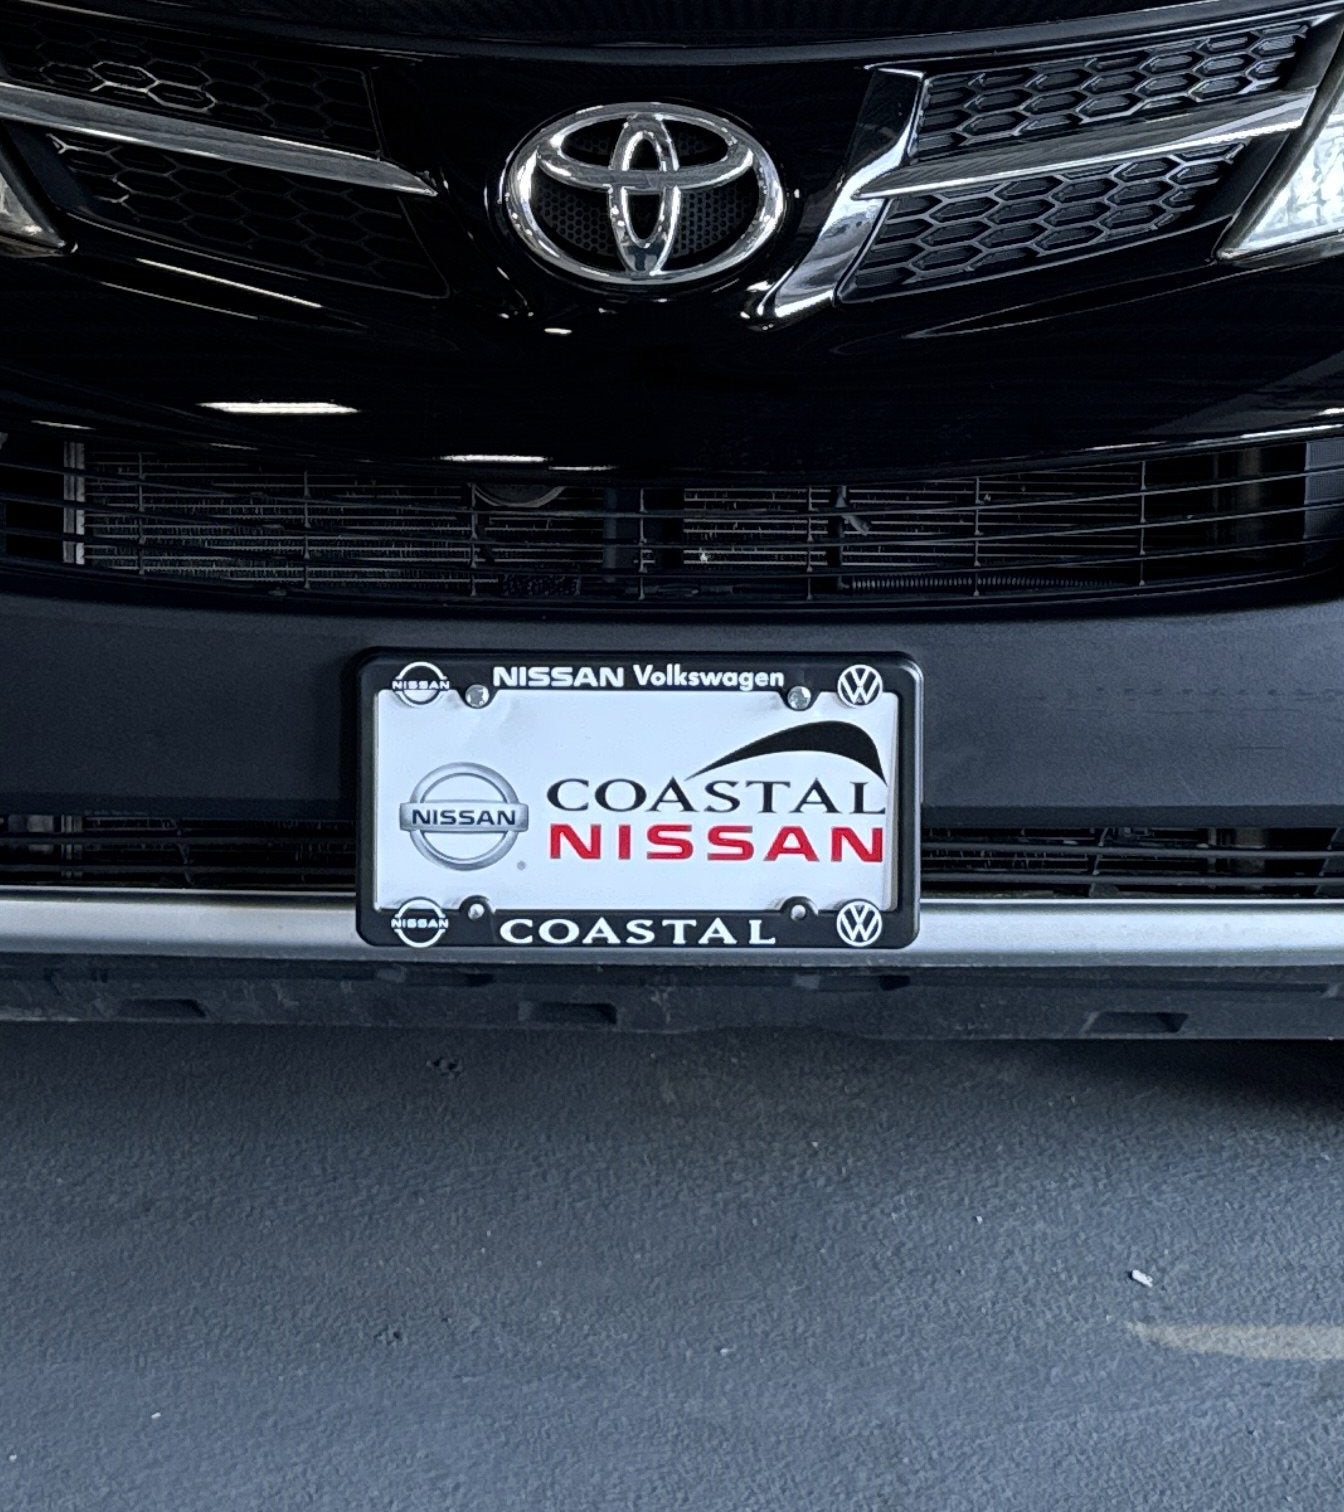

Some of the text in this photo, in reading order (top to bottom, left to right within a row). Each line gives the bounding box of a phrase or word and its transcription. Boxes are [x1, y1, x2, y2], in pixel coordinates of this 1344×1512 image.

[392, 680, 450, 690] NISSAN
[493, 663, 785, 691] NISSAN Volkswagen
[547, 776, 886, 815] COASTAL
[412, 809, 516, 826] NISSAN
[549, 823, 883, 862] NISSAN
[390, 918, 449, 929] NISSAN
[499, 918, 776, 945] COASTAL
